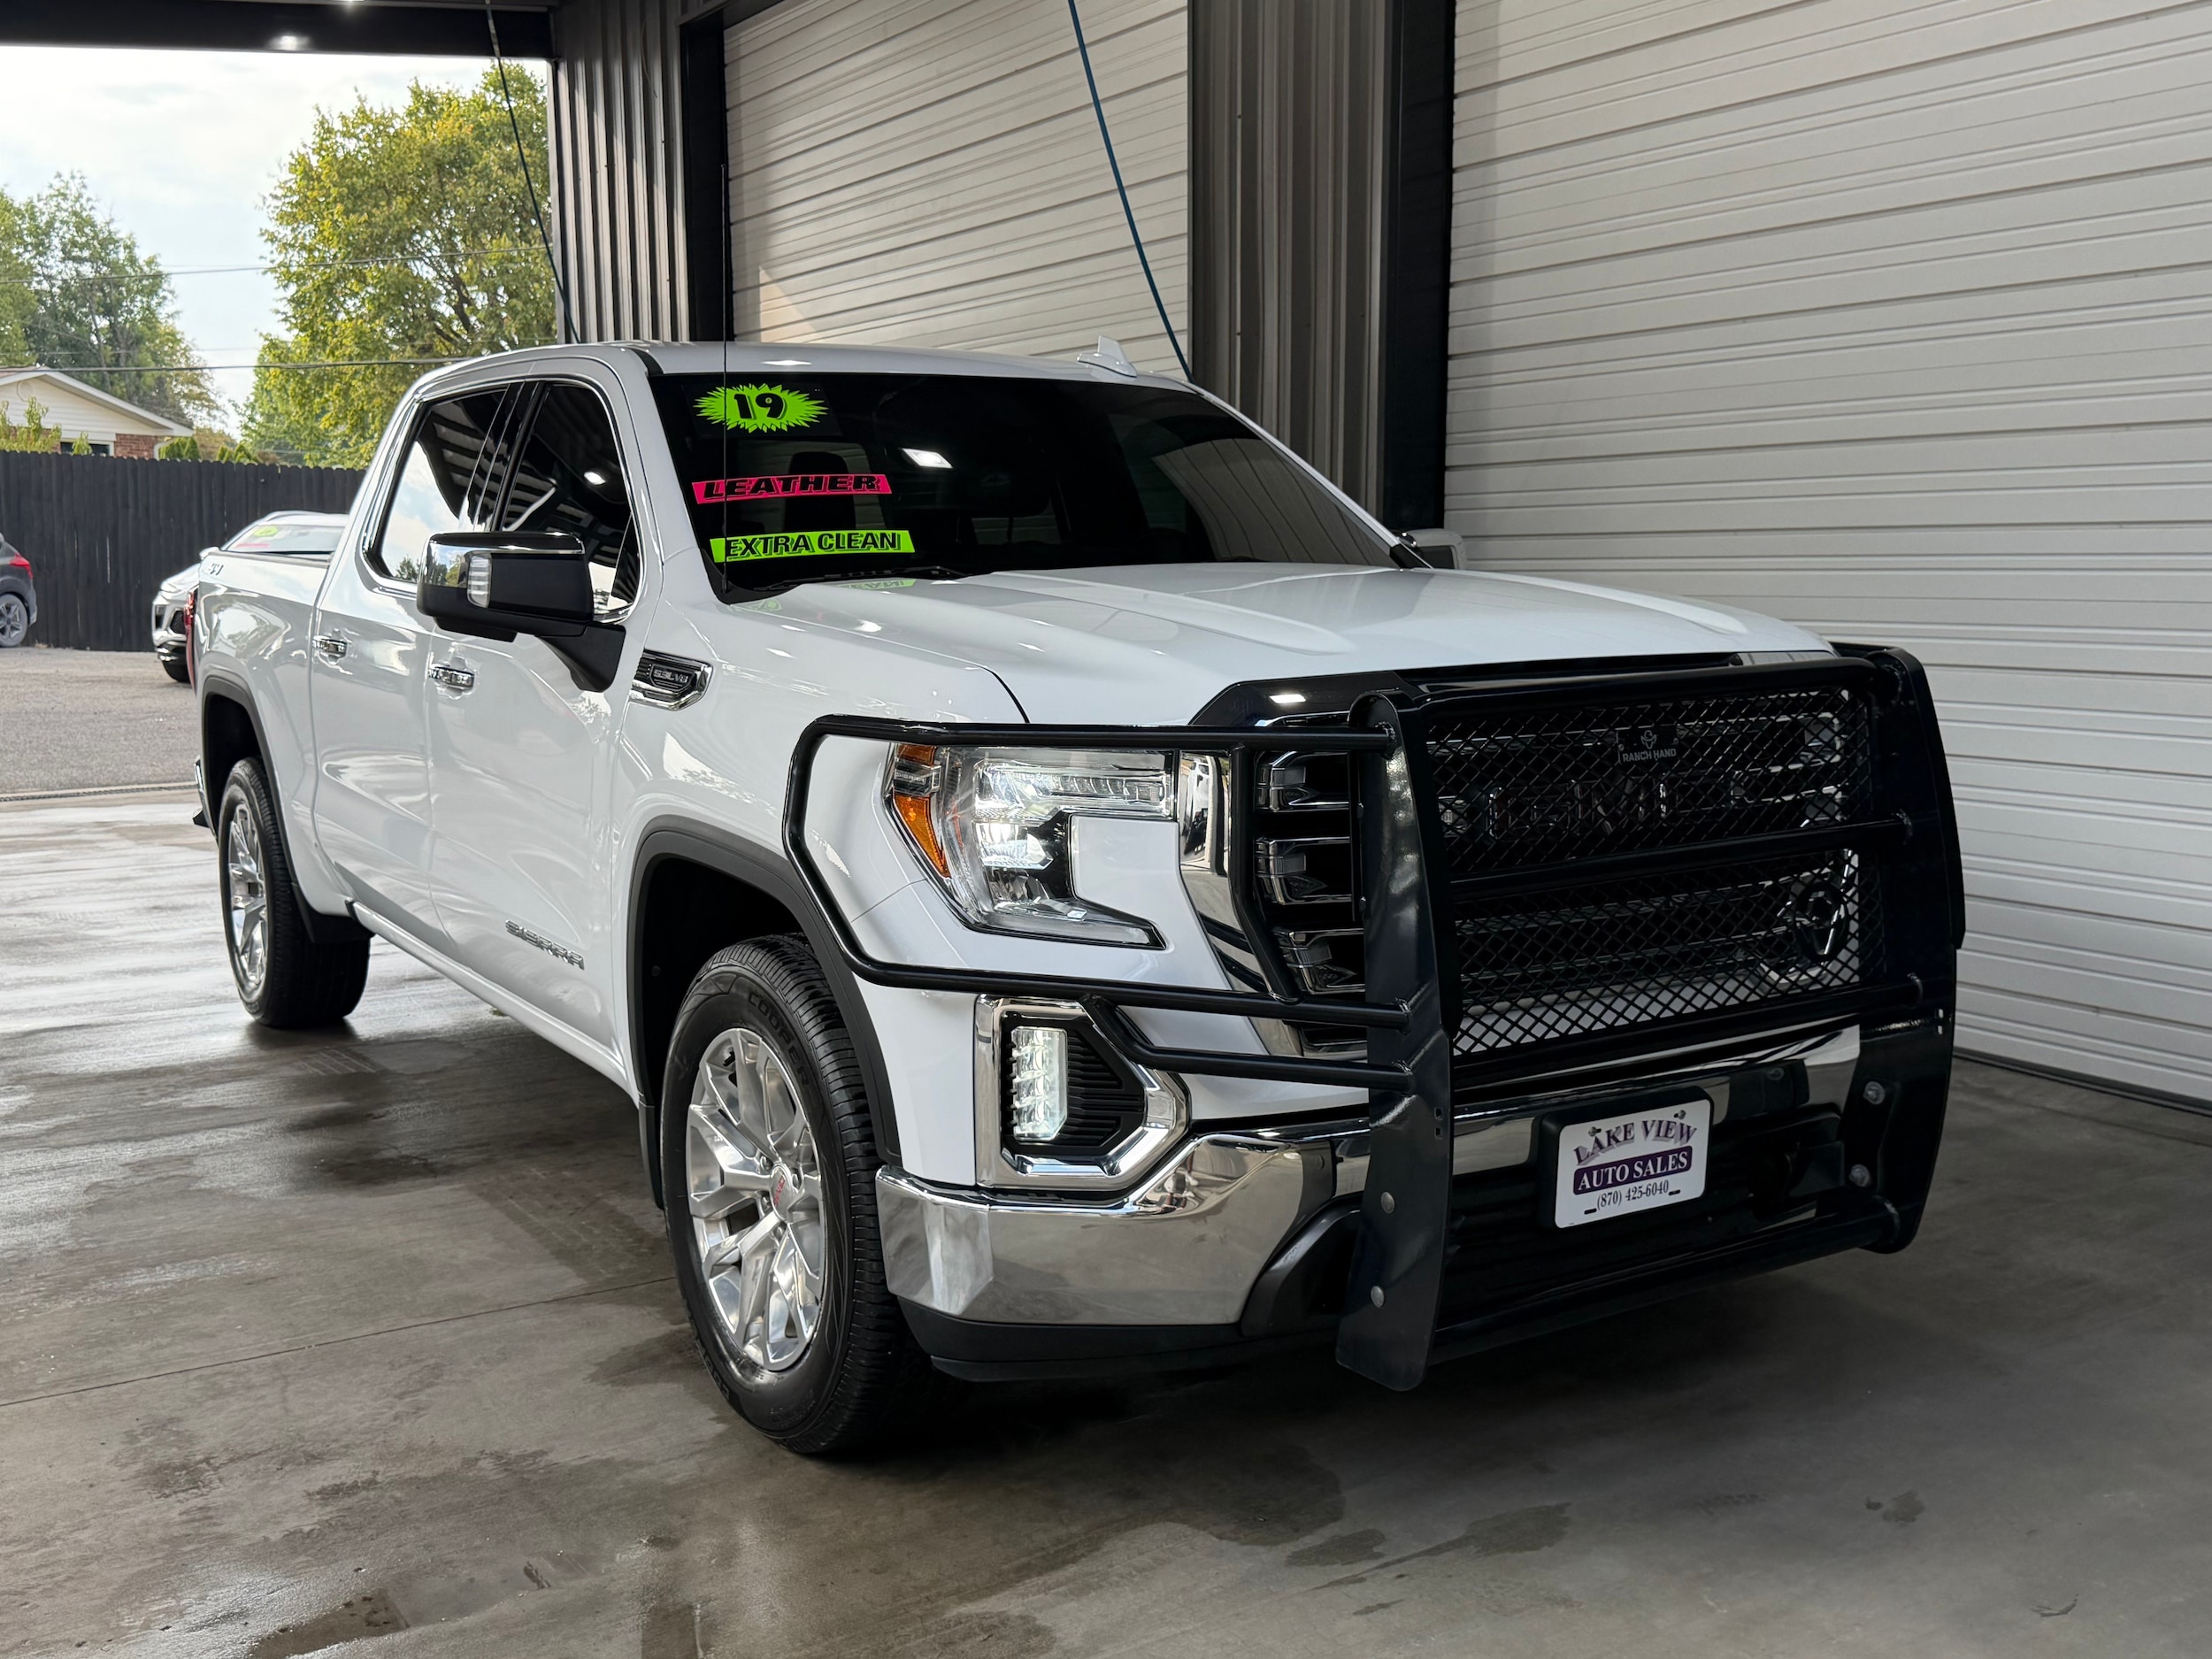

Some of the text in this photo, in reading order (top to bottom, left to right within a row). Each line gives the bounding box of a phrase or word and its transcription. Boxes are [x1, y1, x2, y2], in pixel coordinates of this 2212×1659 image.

[733, 392, 787, 420] 19
[703, 475, 880, 499] LEATHER
[726, 532, 901, 559] EXTRA CLEAN
[1623, 748, 1677, 762] RANCH HAND
[749, 990, 810, 1087] COOPER
[1573, 1119, 1697, 1165] LAKE VIEW
[1578, 1151, 1688, 1191] AUTO SALES
[1596, 1179, 1670, 1210] (870) 425-6040
